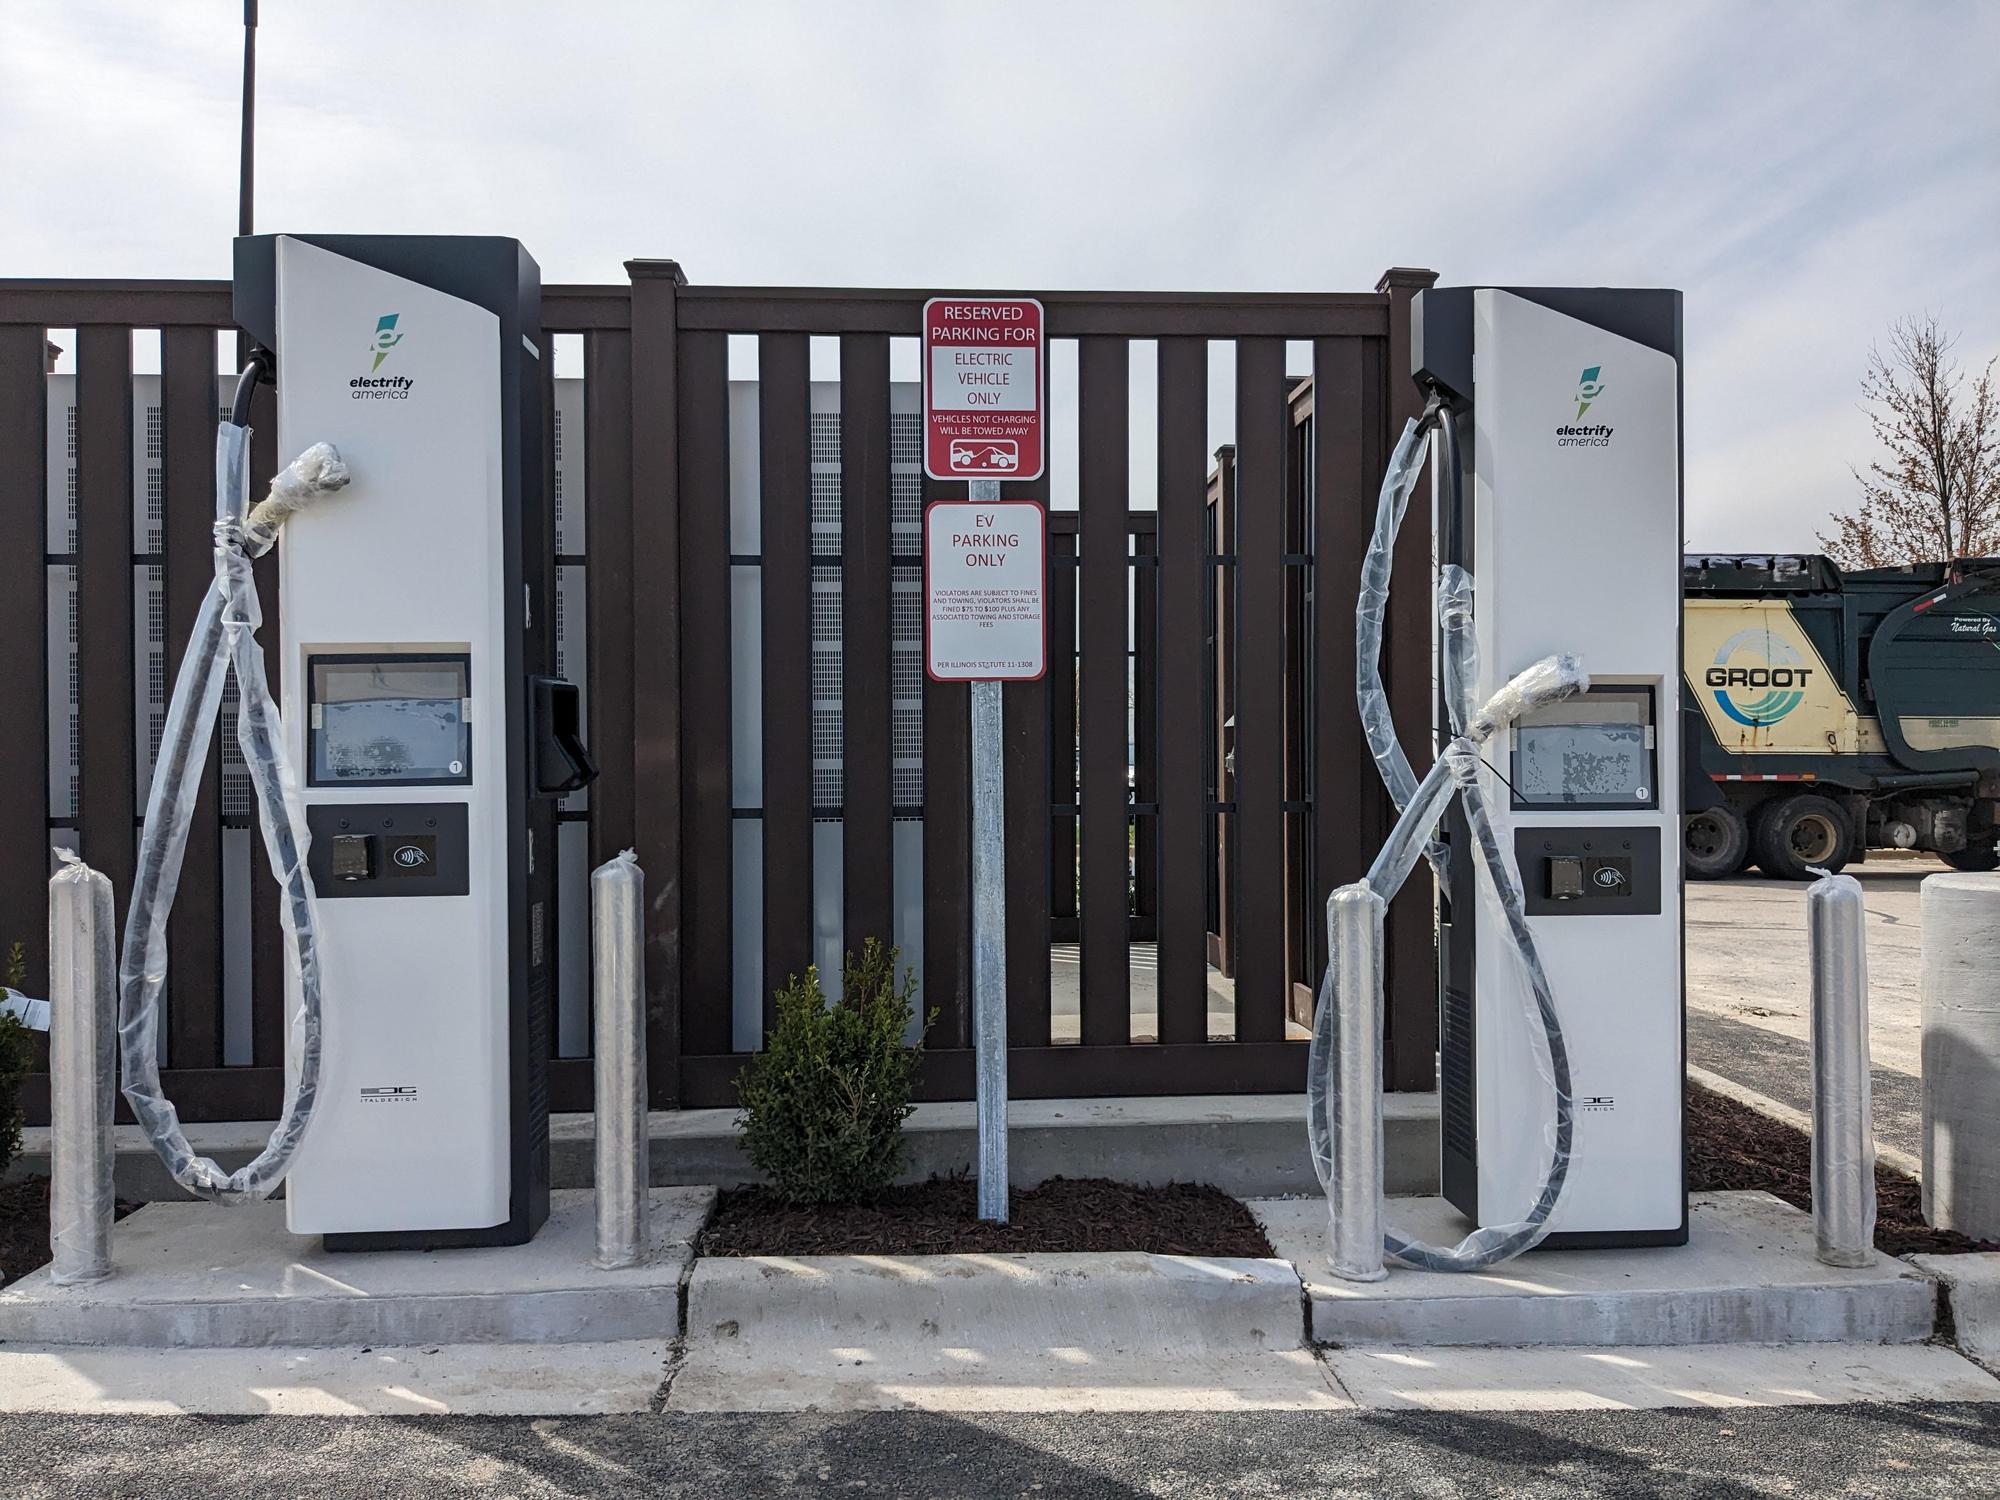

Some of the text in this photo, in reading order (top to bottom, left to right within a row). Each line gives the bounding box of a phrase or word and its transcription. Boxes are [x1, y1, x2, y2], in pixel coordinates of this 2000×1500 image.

[944, 307, 1023, 320] RESERVED
[932, 328, 1035, 341] PARKING FOR
[955, 353, 1013, 365] ELECTRIC
[350, 377, 413, 390] electrify
[958, 373, 1010, 385] VEHICLE
[352, 389, 408, 399] america
[967, 392, 1001, 405] ONLY
[933, 415, 971, 423] VEHICLES
[940, 427, 1028, 435] WILL BE TOWED AWAY
[1556, 425, 1613, 438] electrify
[1558, 437, 1609, 447] america
[976, 515, 994, 527] EV
[953, 534, 1019, 547] PARKING
[966, 554, 1006, 566] ONLY
[1951, 622, 1997, 635] Natural Gas
[1706, 668, 1812, 687] GROOT
